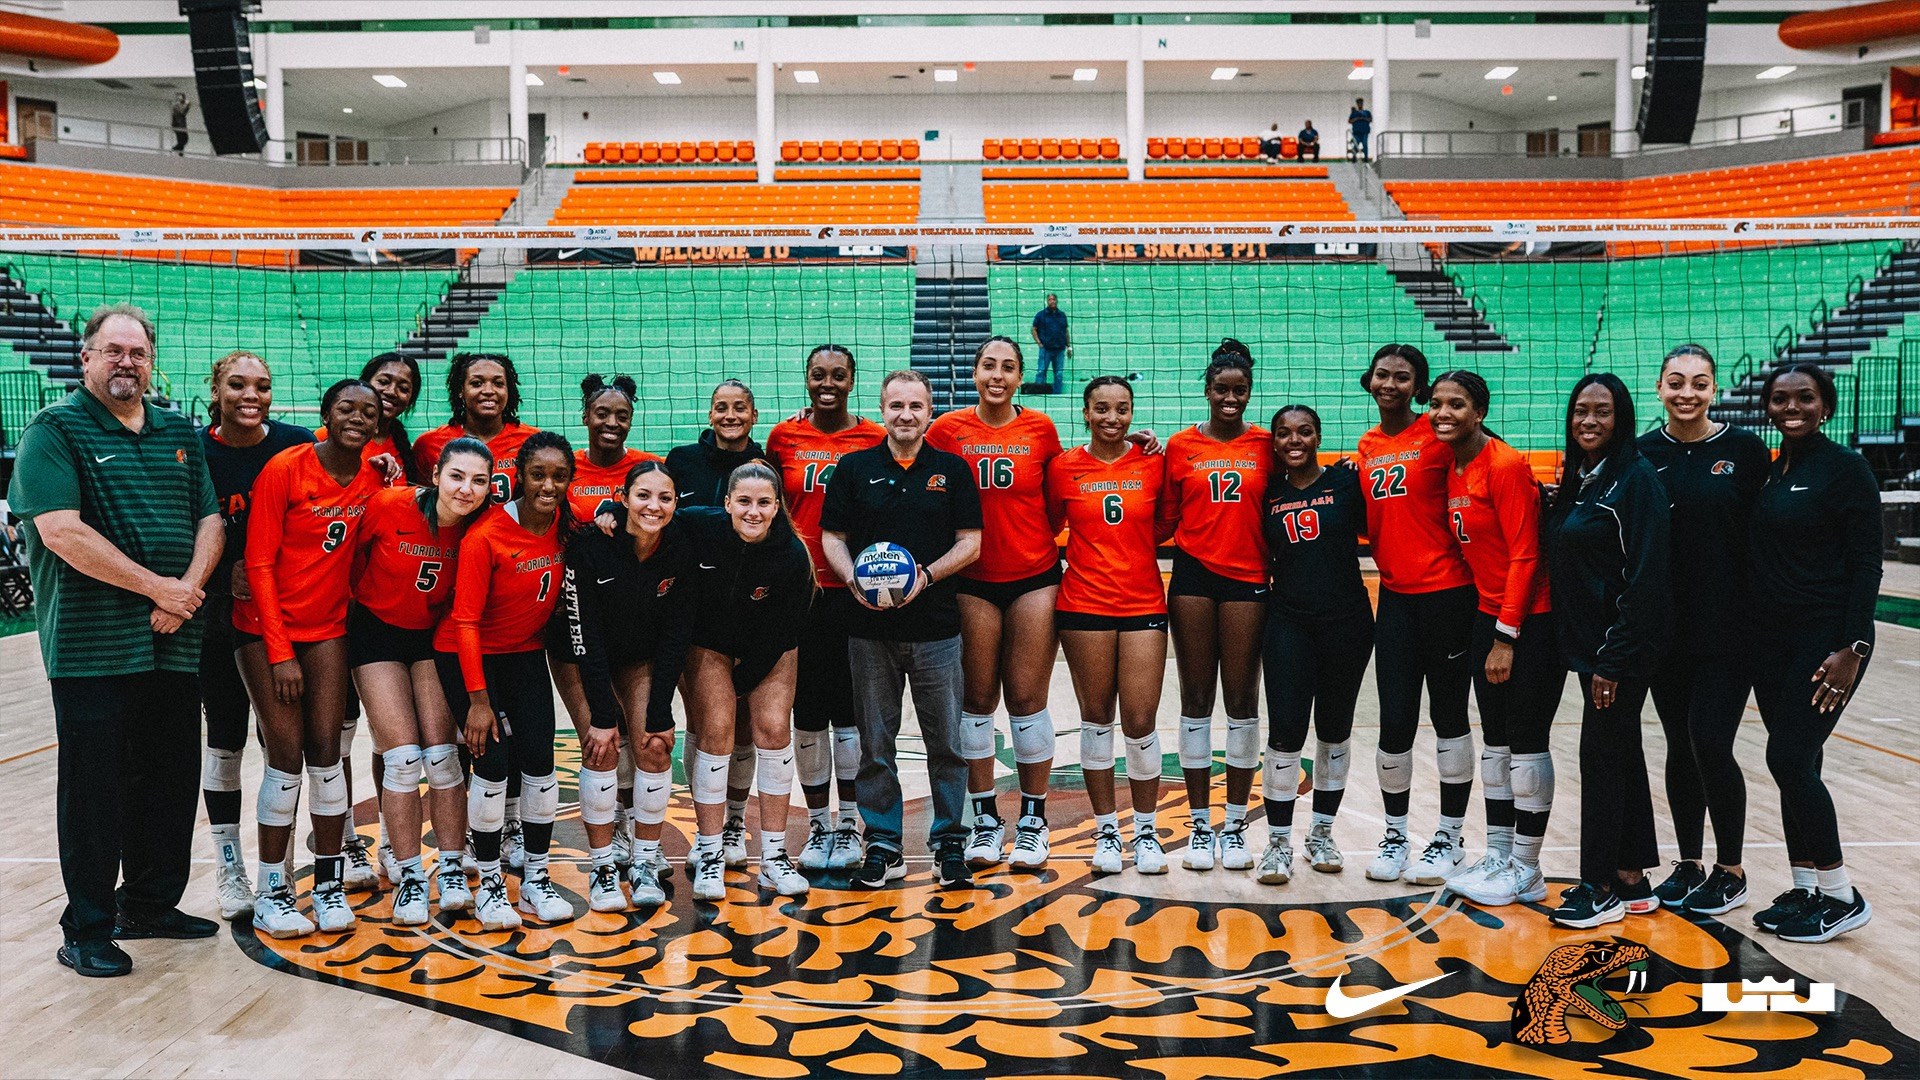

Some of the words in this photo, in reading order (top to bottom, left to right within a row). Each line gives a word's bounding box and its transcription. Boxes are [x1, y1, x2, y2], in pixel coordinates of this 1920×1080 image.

[734, 40, 744, 51] M
[1158, 38, 1167, 48] N
[404, 231, 438, 239] FLORIDA
[920, 228, 970, 236] VOLLEYBALL
[1102, 227, 1135, 235] FLORIDA
[1380, 225, 1431, 233] VOLLEYBALL
[1558, 224, 1592, 232] FLORIDA
[243, 232, 294, 240] VOLLEYBALL
[1143, 243, 1226, 259] SNAKE
[795, 450, 832, 461] FLORIDA
[963, 444, 1003, 455] FLORIDA
[1007, 444, 1030, 455] A&M
[1397, 449, 1420, 461] A&M
[1193, 459, 1231, 472] FLORIDA
[1235, 460, 1257, 470] A&M
[804, 462, 837, 494] 14
[977, 457, 1015, 490] 16
[1080, 481, 1119, 494] FLORIDA
[1122, 479, 1143, 490] A&M
[1208, 471, 1242, 503] 12
[1370, 464, 1408, 501] 22
[573, 485, 611, 497] FLORIDA
[1103, 493, 1124, 525] 6
[1271, 500, 1308, 515] FLORIDA
[1311, 495, 1334, 506] A&M
[1283, 508, 1320, 543] 19
[322, 520, 347, 553] 9
[399, 541, 441, 558] FLORIDA
[516, 555, 551, 573] FLORIDA
[864, 551, 900, 563] molten
[867, 562, 898, 575] NCAA
[415, 560, 442, 593] 5
[536, 570, 551, 602] 1
[565, 564, 587, 656] RATTLERS
